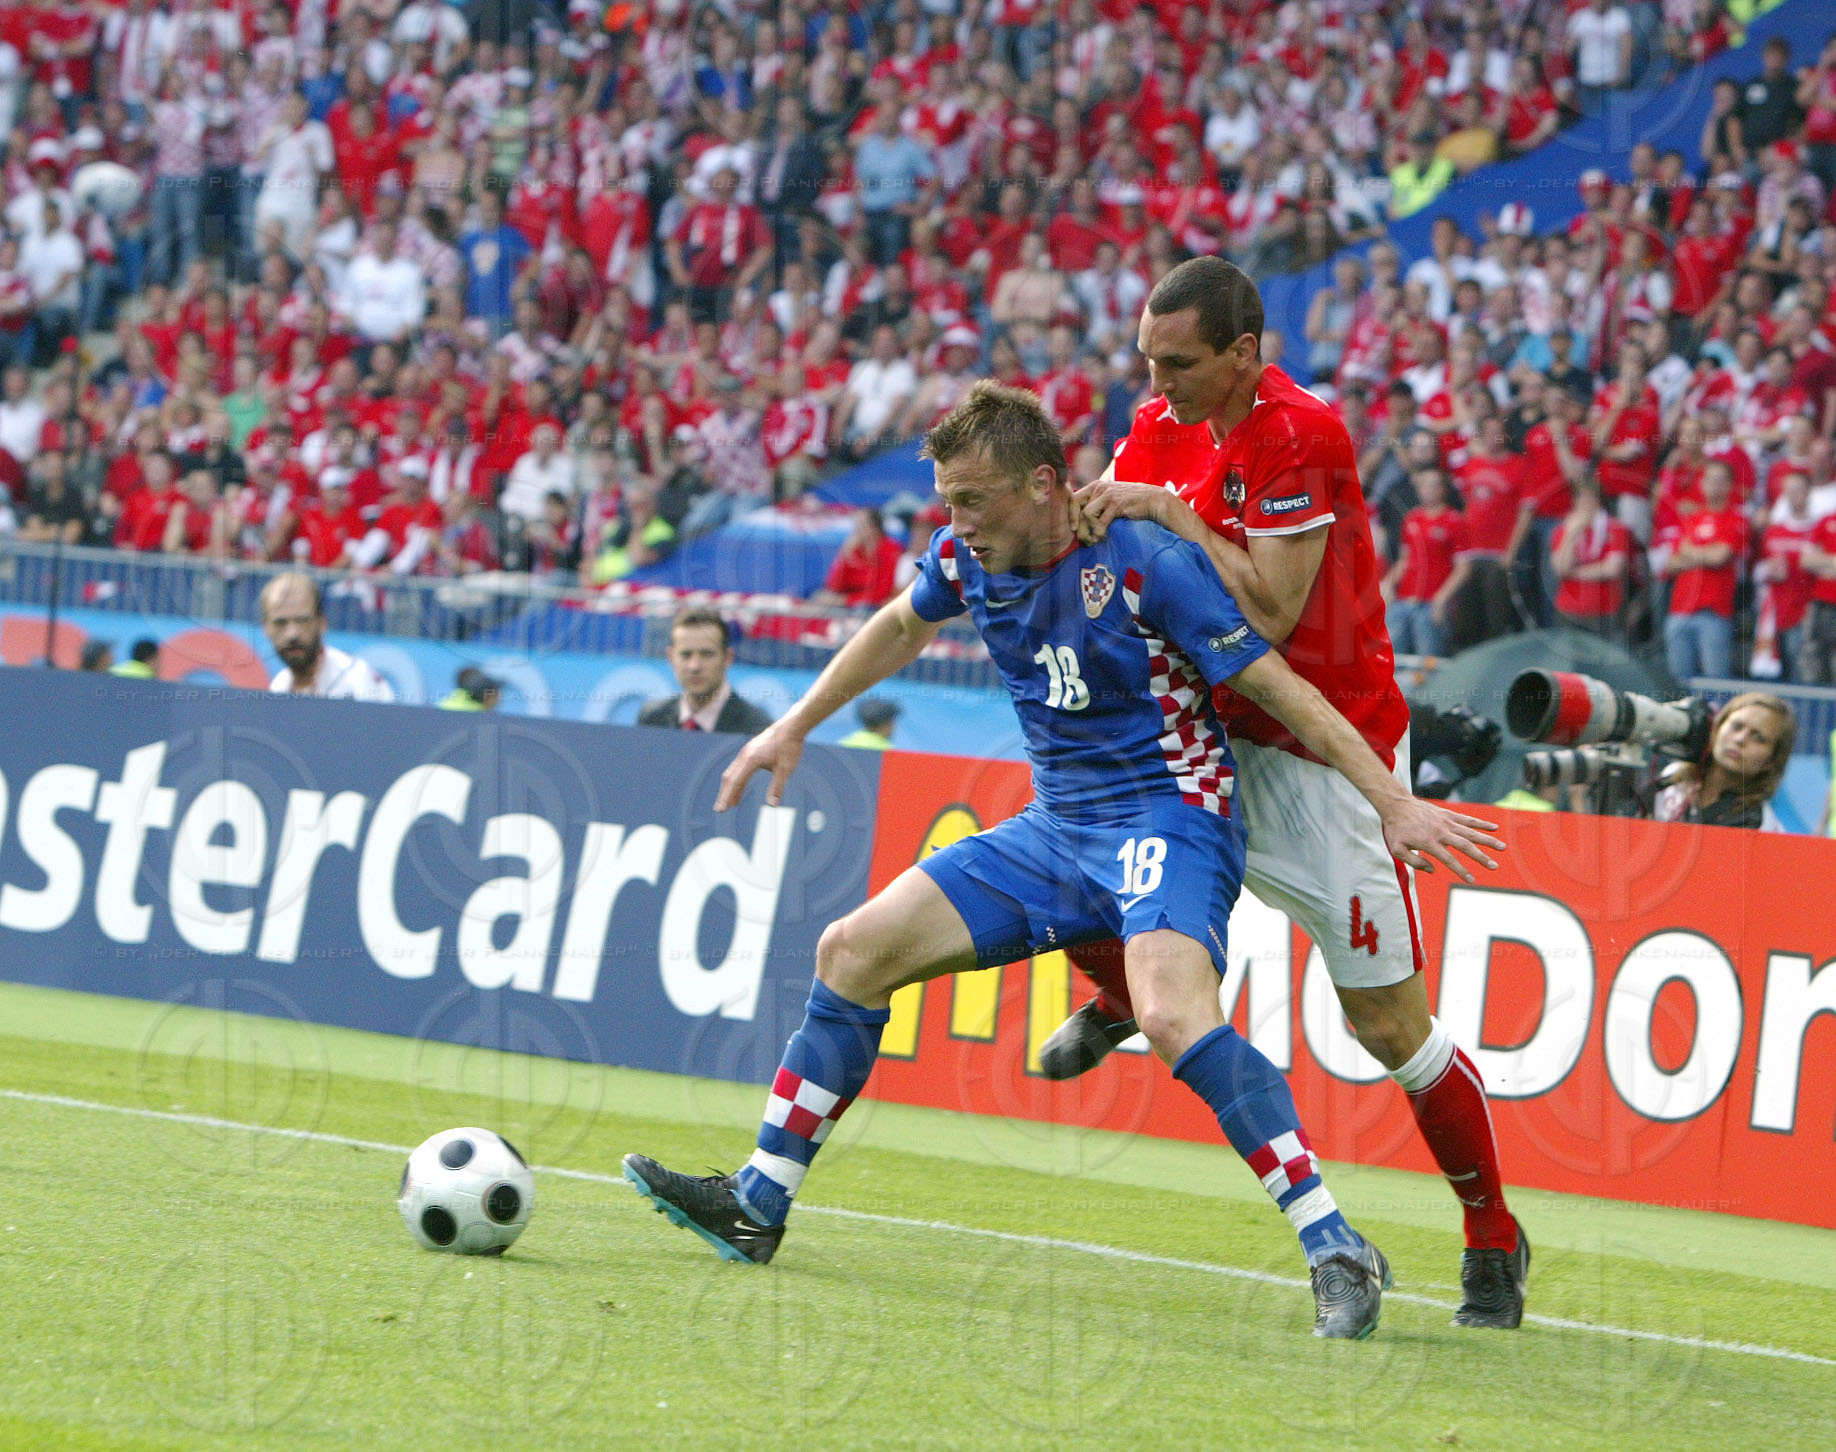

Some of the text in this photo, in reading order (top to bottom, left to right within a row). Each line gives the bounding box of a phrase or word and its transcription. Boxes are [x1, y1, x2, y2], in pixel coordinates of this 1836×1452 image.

[1272, 496, 1310, 511] RESPECT
[1221, 625, 1250, 645] RESPECT
[1033, 644, 1091, 711] 18
[0, 740, 796, 1021] sterCard
[1116, 837, 1167, 894] 18
[1349, 894, 1379, 956] 4
